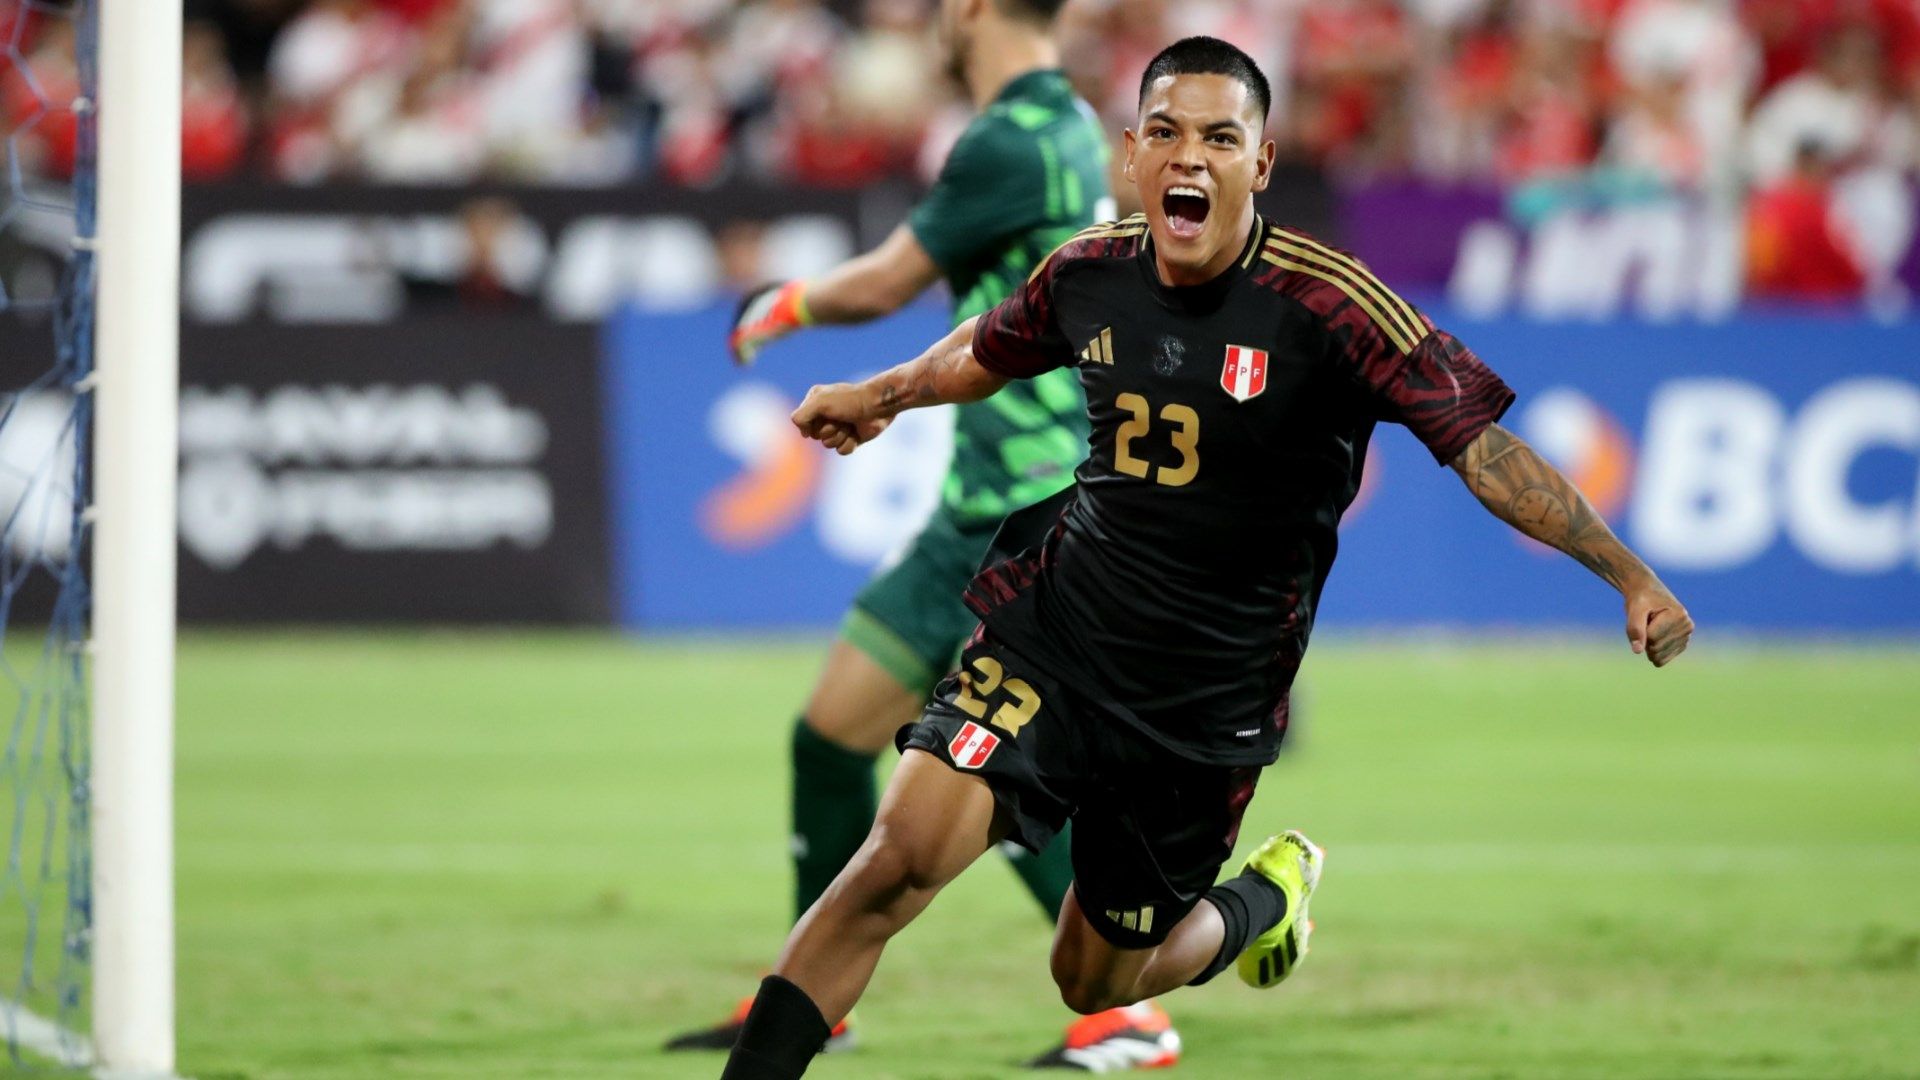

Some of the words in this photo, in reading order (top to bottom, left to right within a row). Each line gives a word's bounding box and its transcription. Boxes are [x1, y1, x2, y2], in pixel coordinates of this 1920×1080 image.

[1228, 363, 1261, 379] FPF
[1114, 392, 1200, 487] 23
[1630, 378, 1920, 572] BC
[952, 656, 1041, 738] 23
